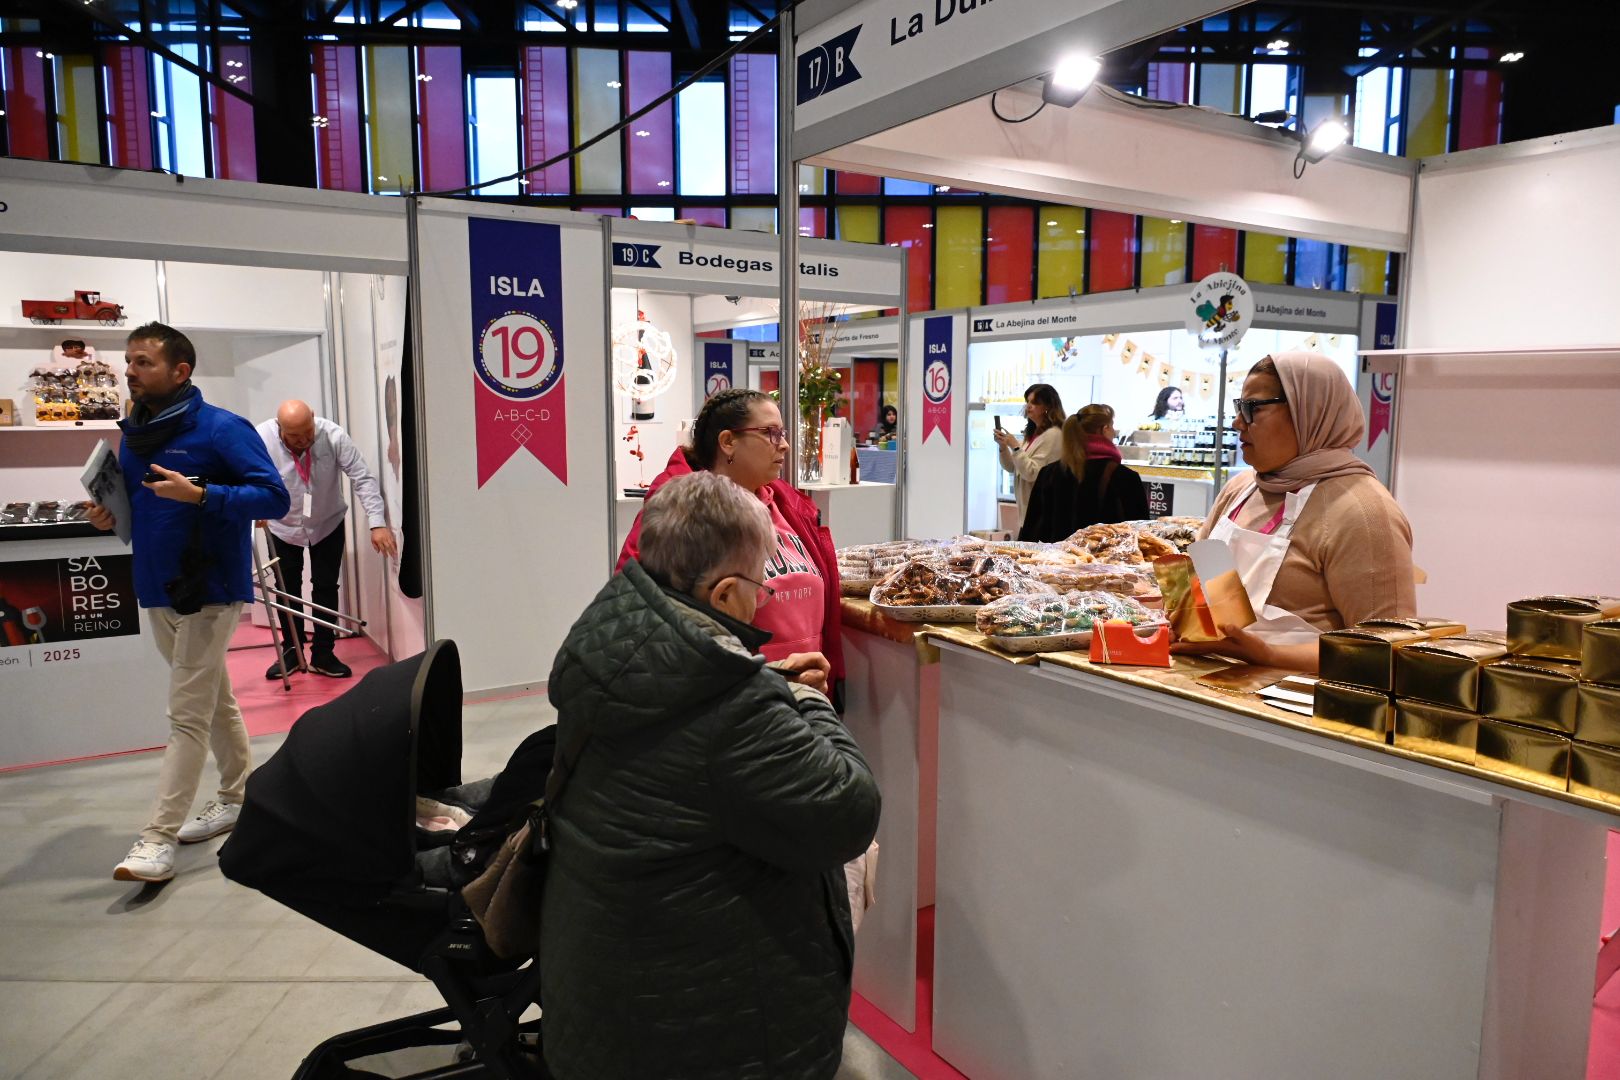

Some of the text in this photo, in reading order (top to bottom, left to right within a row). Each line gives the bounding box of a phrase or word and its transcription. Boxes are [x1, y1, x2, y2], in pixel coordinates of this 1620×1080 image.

[808, 0, 993, 90] 17 B La Du
[622, 247, 839, 277] 19 C Bodegas talis
[489, 275, 545, 298] ISLA
[1255, 303, 1327, 318] La Abejina del Monte
[995, 320, 1005, 329] La
[1006, 317, 1035, 329] Abejina
[1037, 316, 1050, 326] del
[1051, 314, 1077, 325] Monte
[859, 332, 880, 340] Fresno
[1380, 334, 1395, 346] ISL
[491, 325, 545, 379] 19
[928, 343, 947, 354] ISLA
[709, 361, 728, 369] ISLA
[928, 367, 946, 393] 16
[493, 408, 551, 422] A-B-C-D
[1150, 480, 1163, 490] SA
[1150, 491, 1165, 501] BO
[1149, 501, 1168, 512] RES
[67, 555, 102, 572] SA
[70, 574, 109, 592] BO
[72, 592, 121, 612] RES
[775, 586, 812, 603] NEW YORK
[90, 612, 103, 620] UN
[74, 619, 121, 633] REINO
[0, 647, 81, 666] eón 2025
